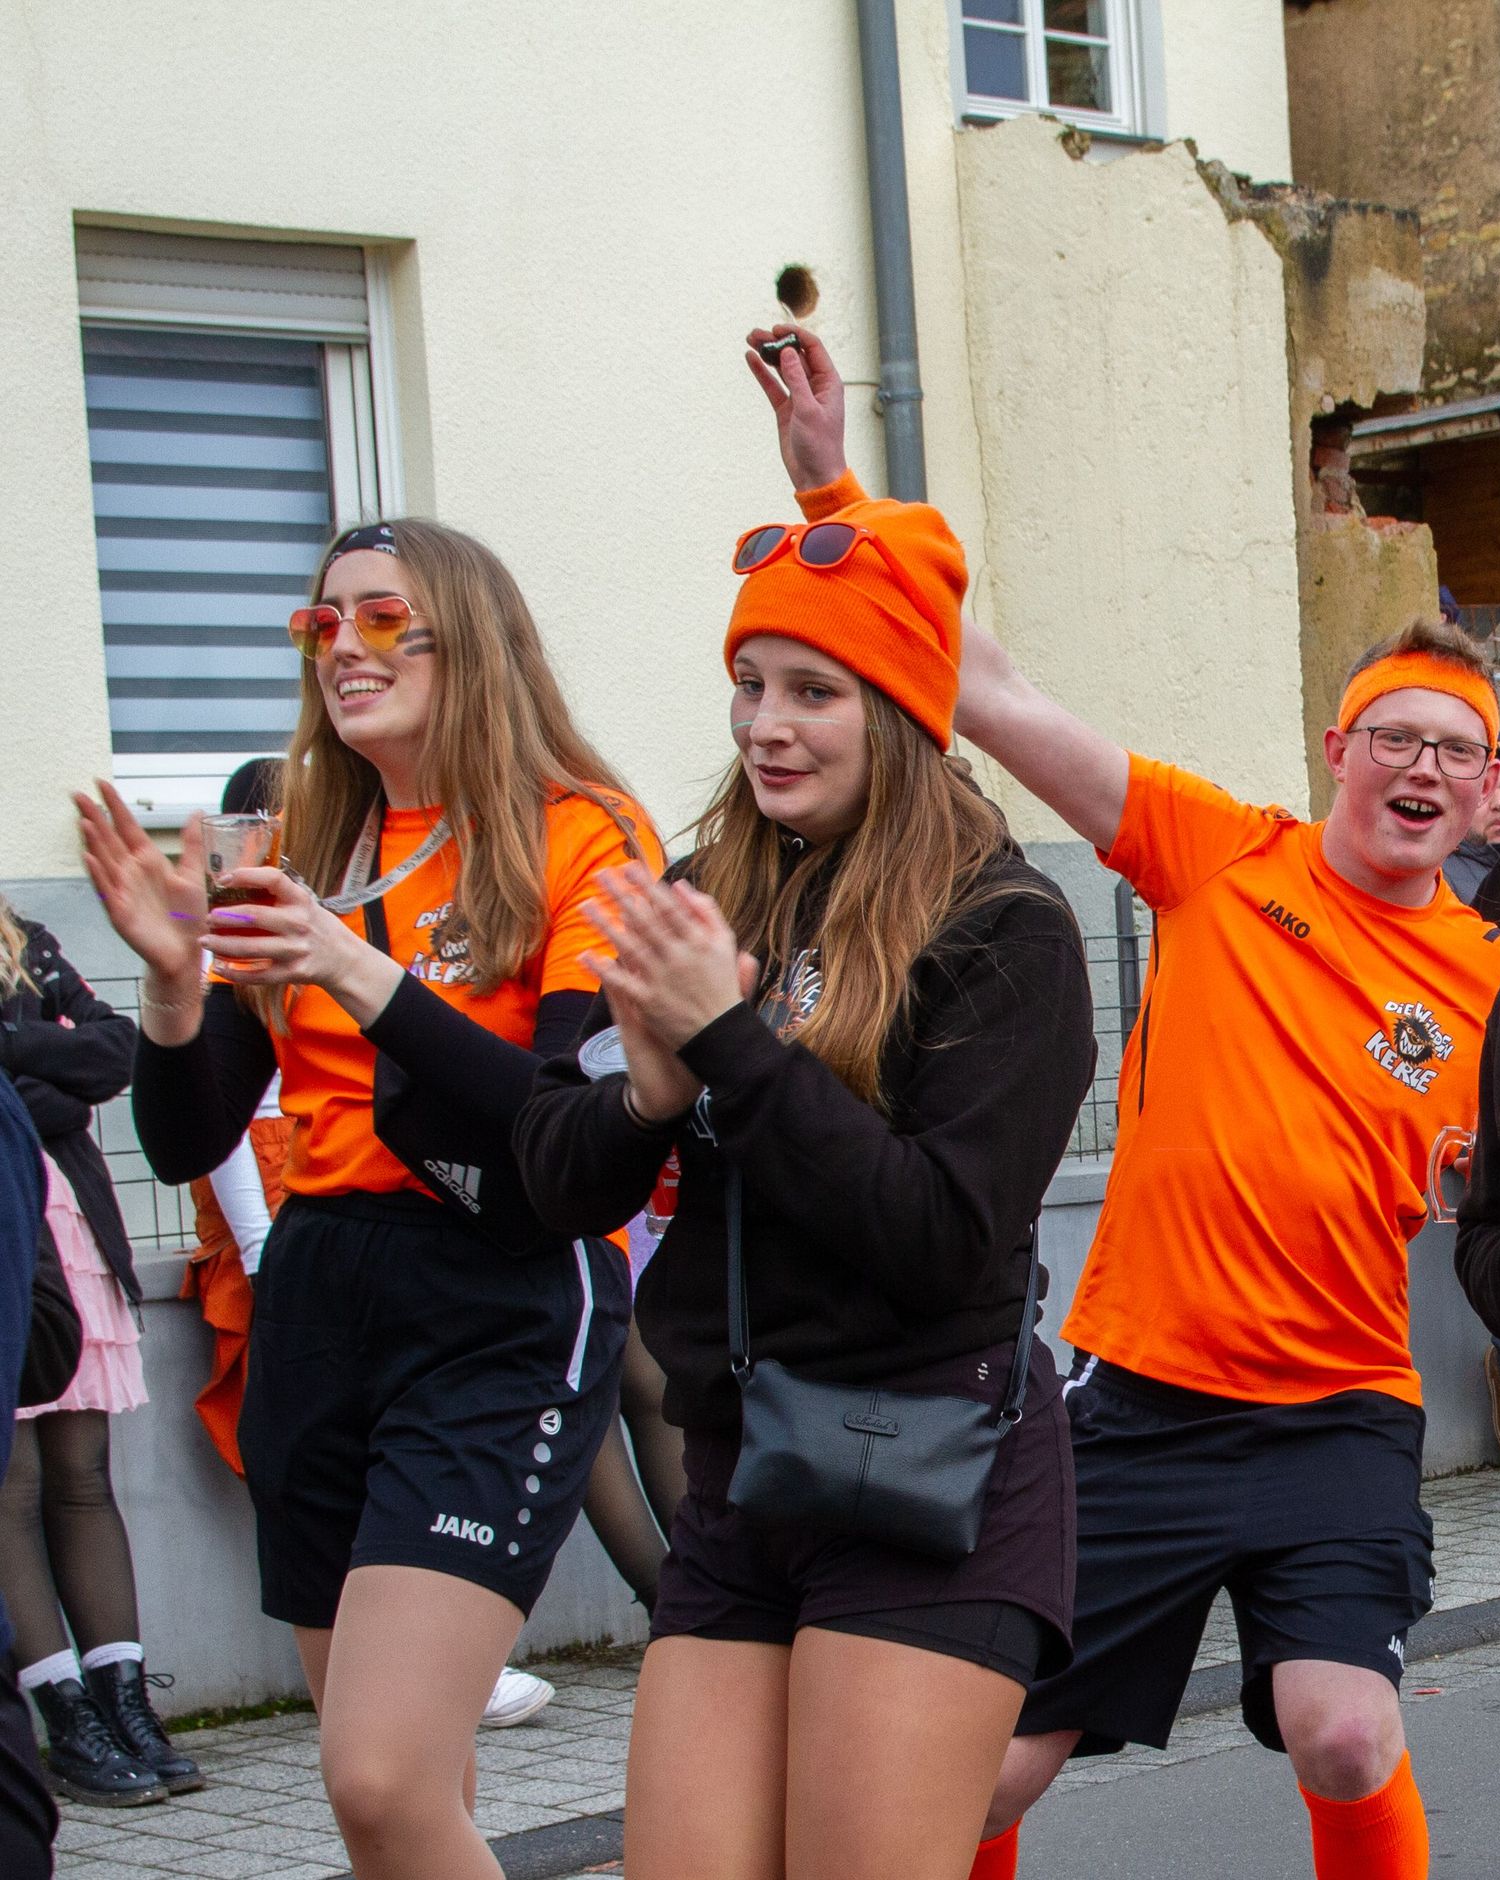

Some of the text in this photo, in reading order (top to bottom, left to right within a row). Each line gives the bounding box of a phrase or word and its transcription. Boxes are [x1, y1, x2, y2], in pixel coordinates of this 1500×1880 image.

[1260, 899, 1311, 939] JAKO
[1364, 1029, 1440, 1095] KERLE
[424, 1159, 481, 1214] adidas
[430, 1513, 494, 1546] JAKO
